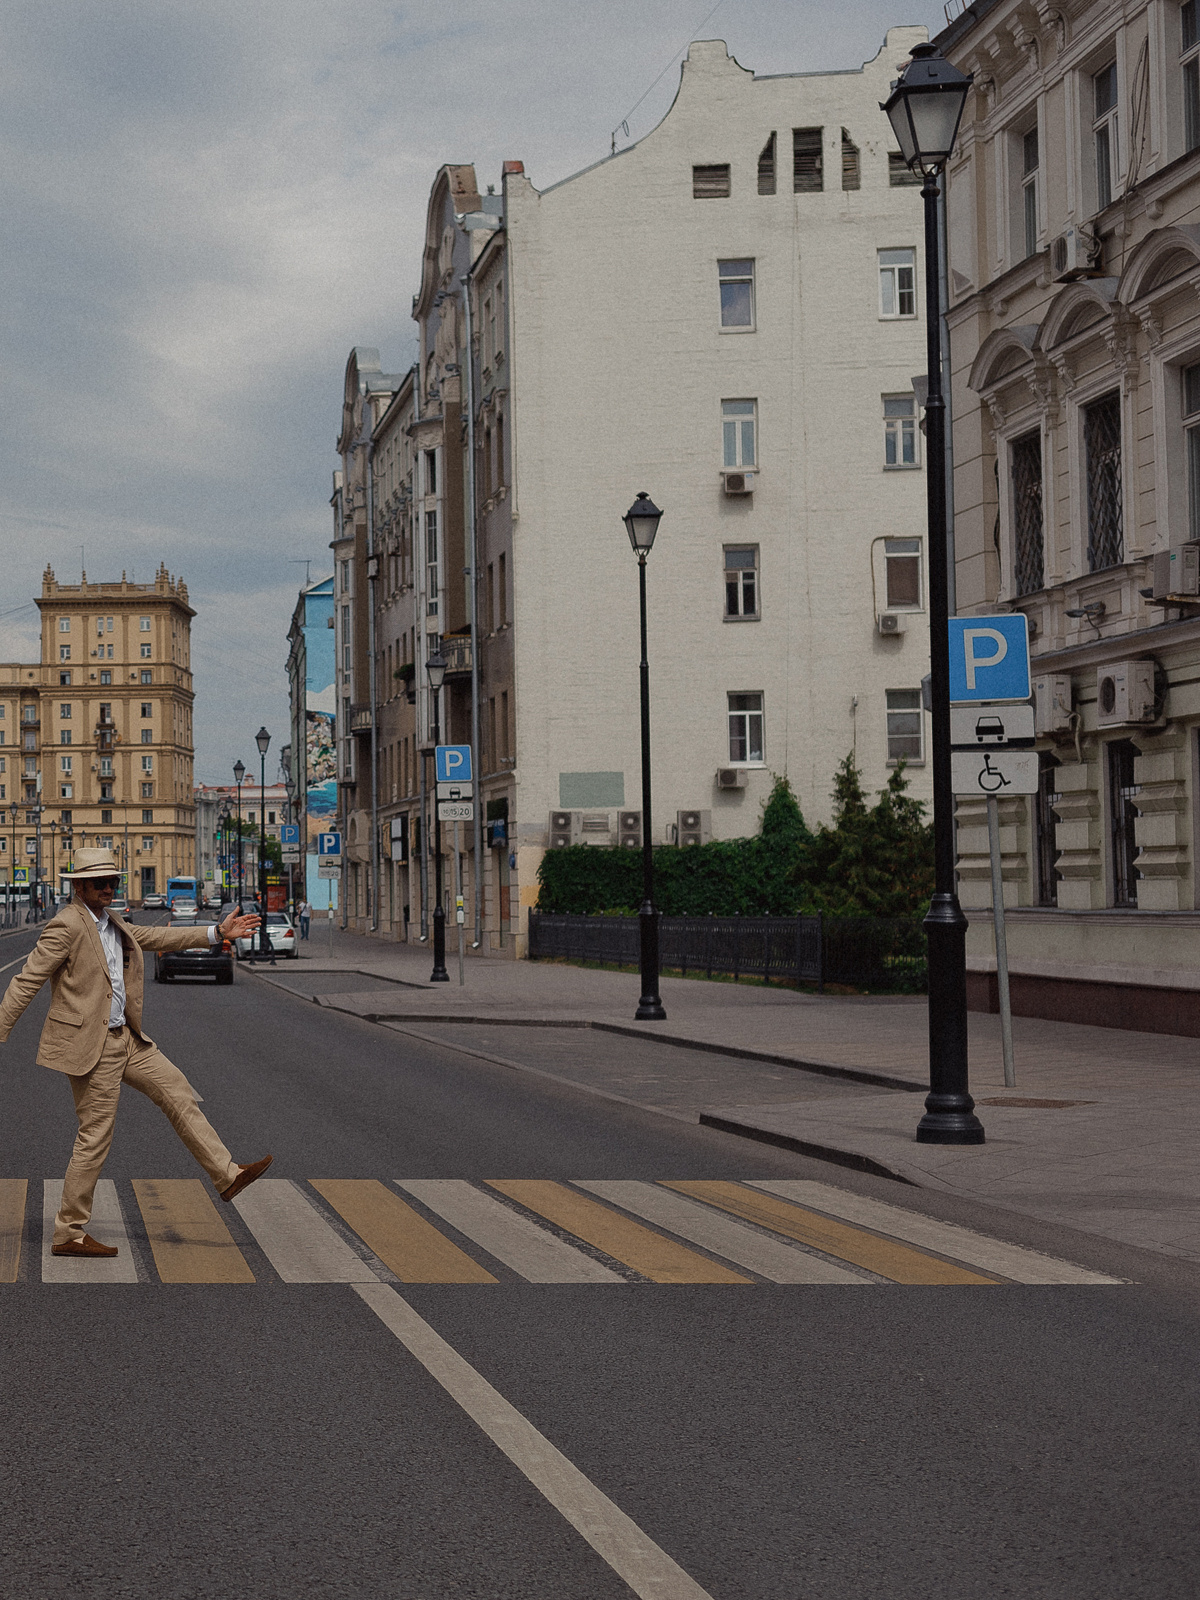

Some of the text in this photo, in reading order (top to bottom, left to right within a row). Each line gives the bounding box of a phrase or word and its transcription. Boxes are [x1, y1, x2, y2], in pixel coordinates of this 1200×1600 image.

[963, 628, 1008, 690] P
[445, 750, 464, 777] P
[459, 808, 470, 816] 20
[285, 827, 295, 841] P
[323, 834, 336, 853] P
